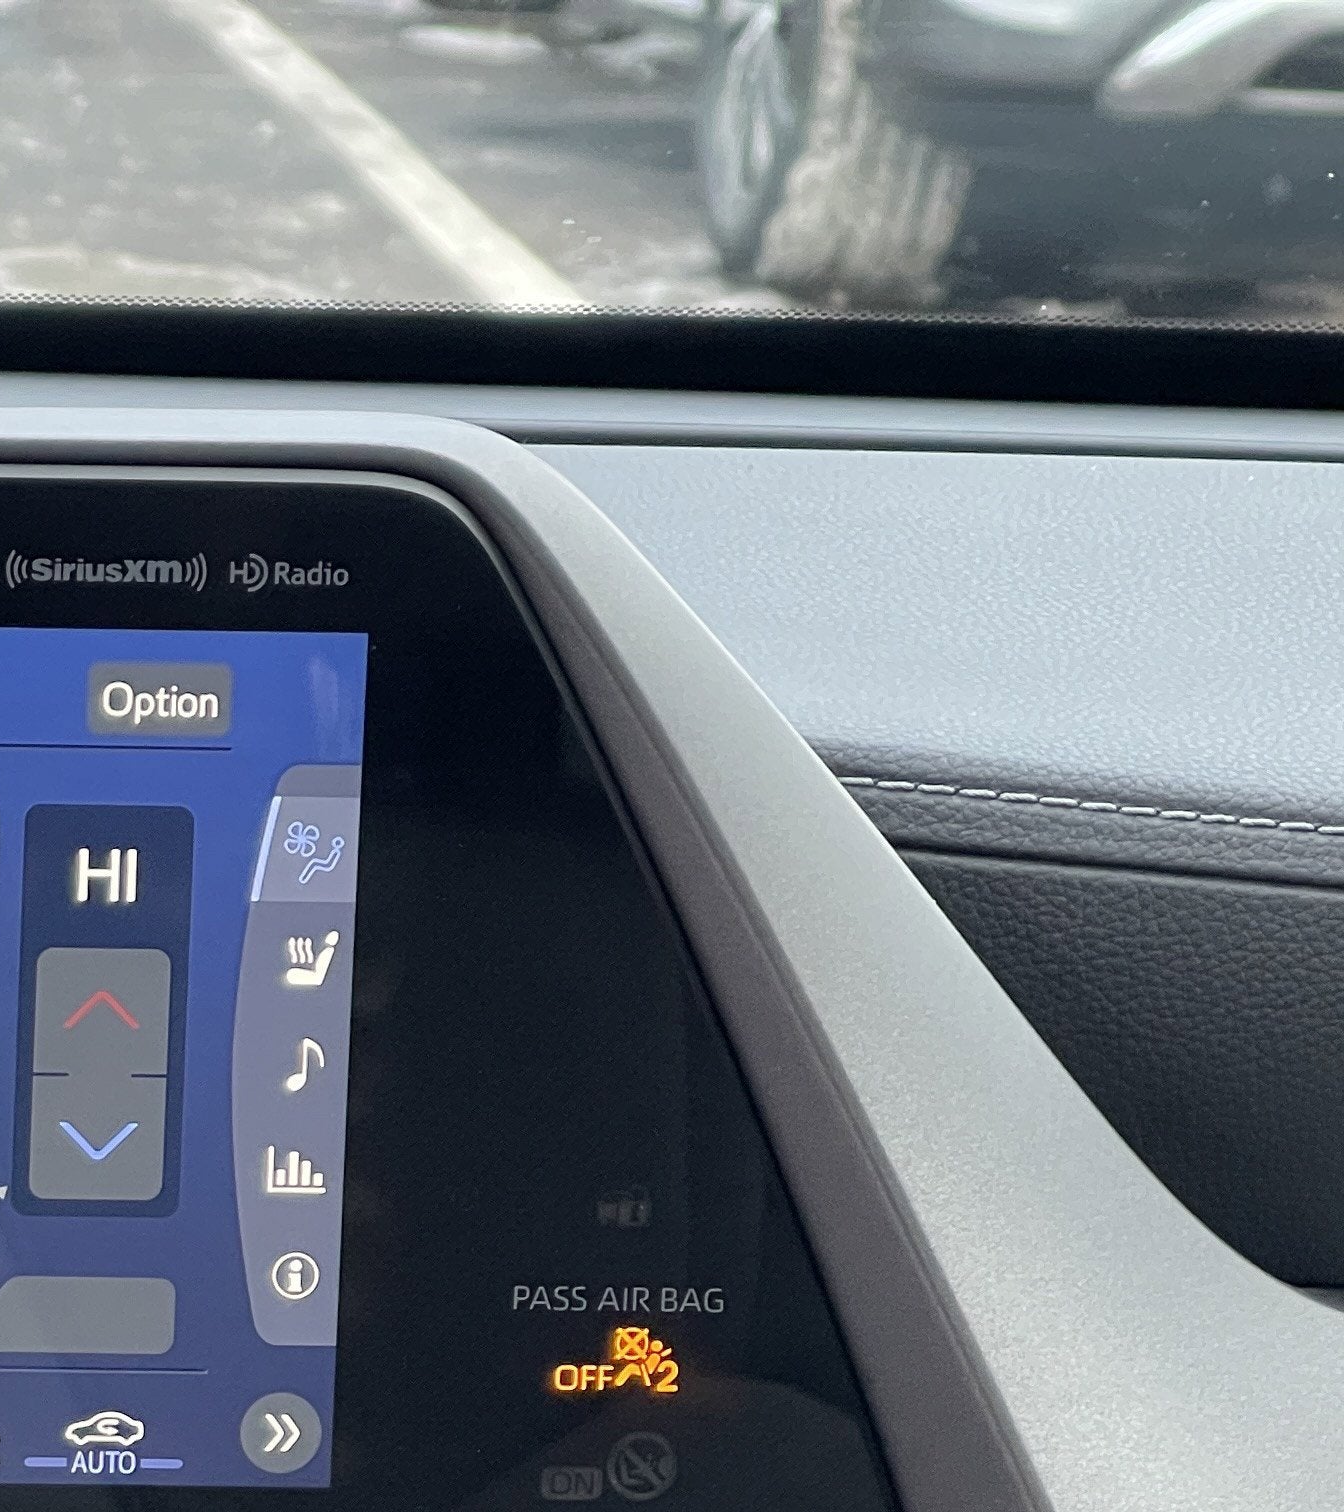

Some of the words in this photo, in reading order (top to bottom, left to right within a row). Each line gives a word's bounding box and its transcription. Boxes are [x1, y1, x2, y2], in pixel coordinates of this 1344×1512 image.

[273, 560, 349, 586] Radio
[102, 681, 219, 725] Option
[76, 847, 138, 904] HI
[513, 1285, 587, 1312] PASS
[597, 1286, 651, 1312] AIR
[660, 1287, 724, 1314] BAG
[554, 1364, 615, 1391] OFF
[70, 1450, 137, 1475] AUTO
